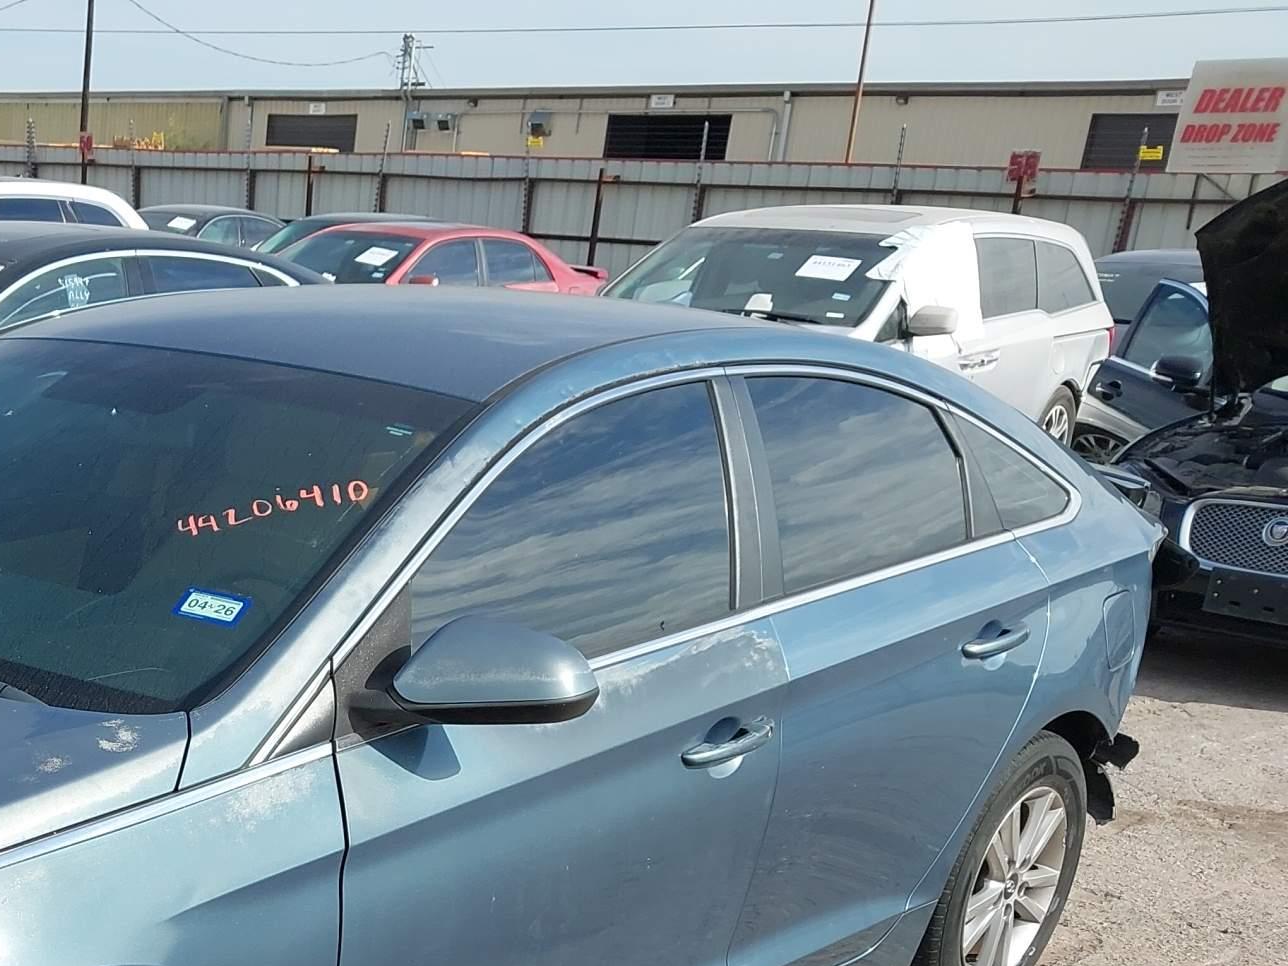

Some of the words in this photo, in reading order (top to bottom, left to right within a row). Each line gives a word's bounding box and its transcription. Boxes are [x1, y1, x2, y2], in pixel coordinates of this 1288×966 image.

[1194, 87, 1285, 113] DEALER
[1181, 123, 1232, 143] DROP
[1231, 122, 1280, 143] ZONE
